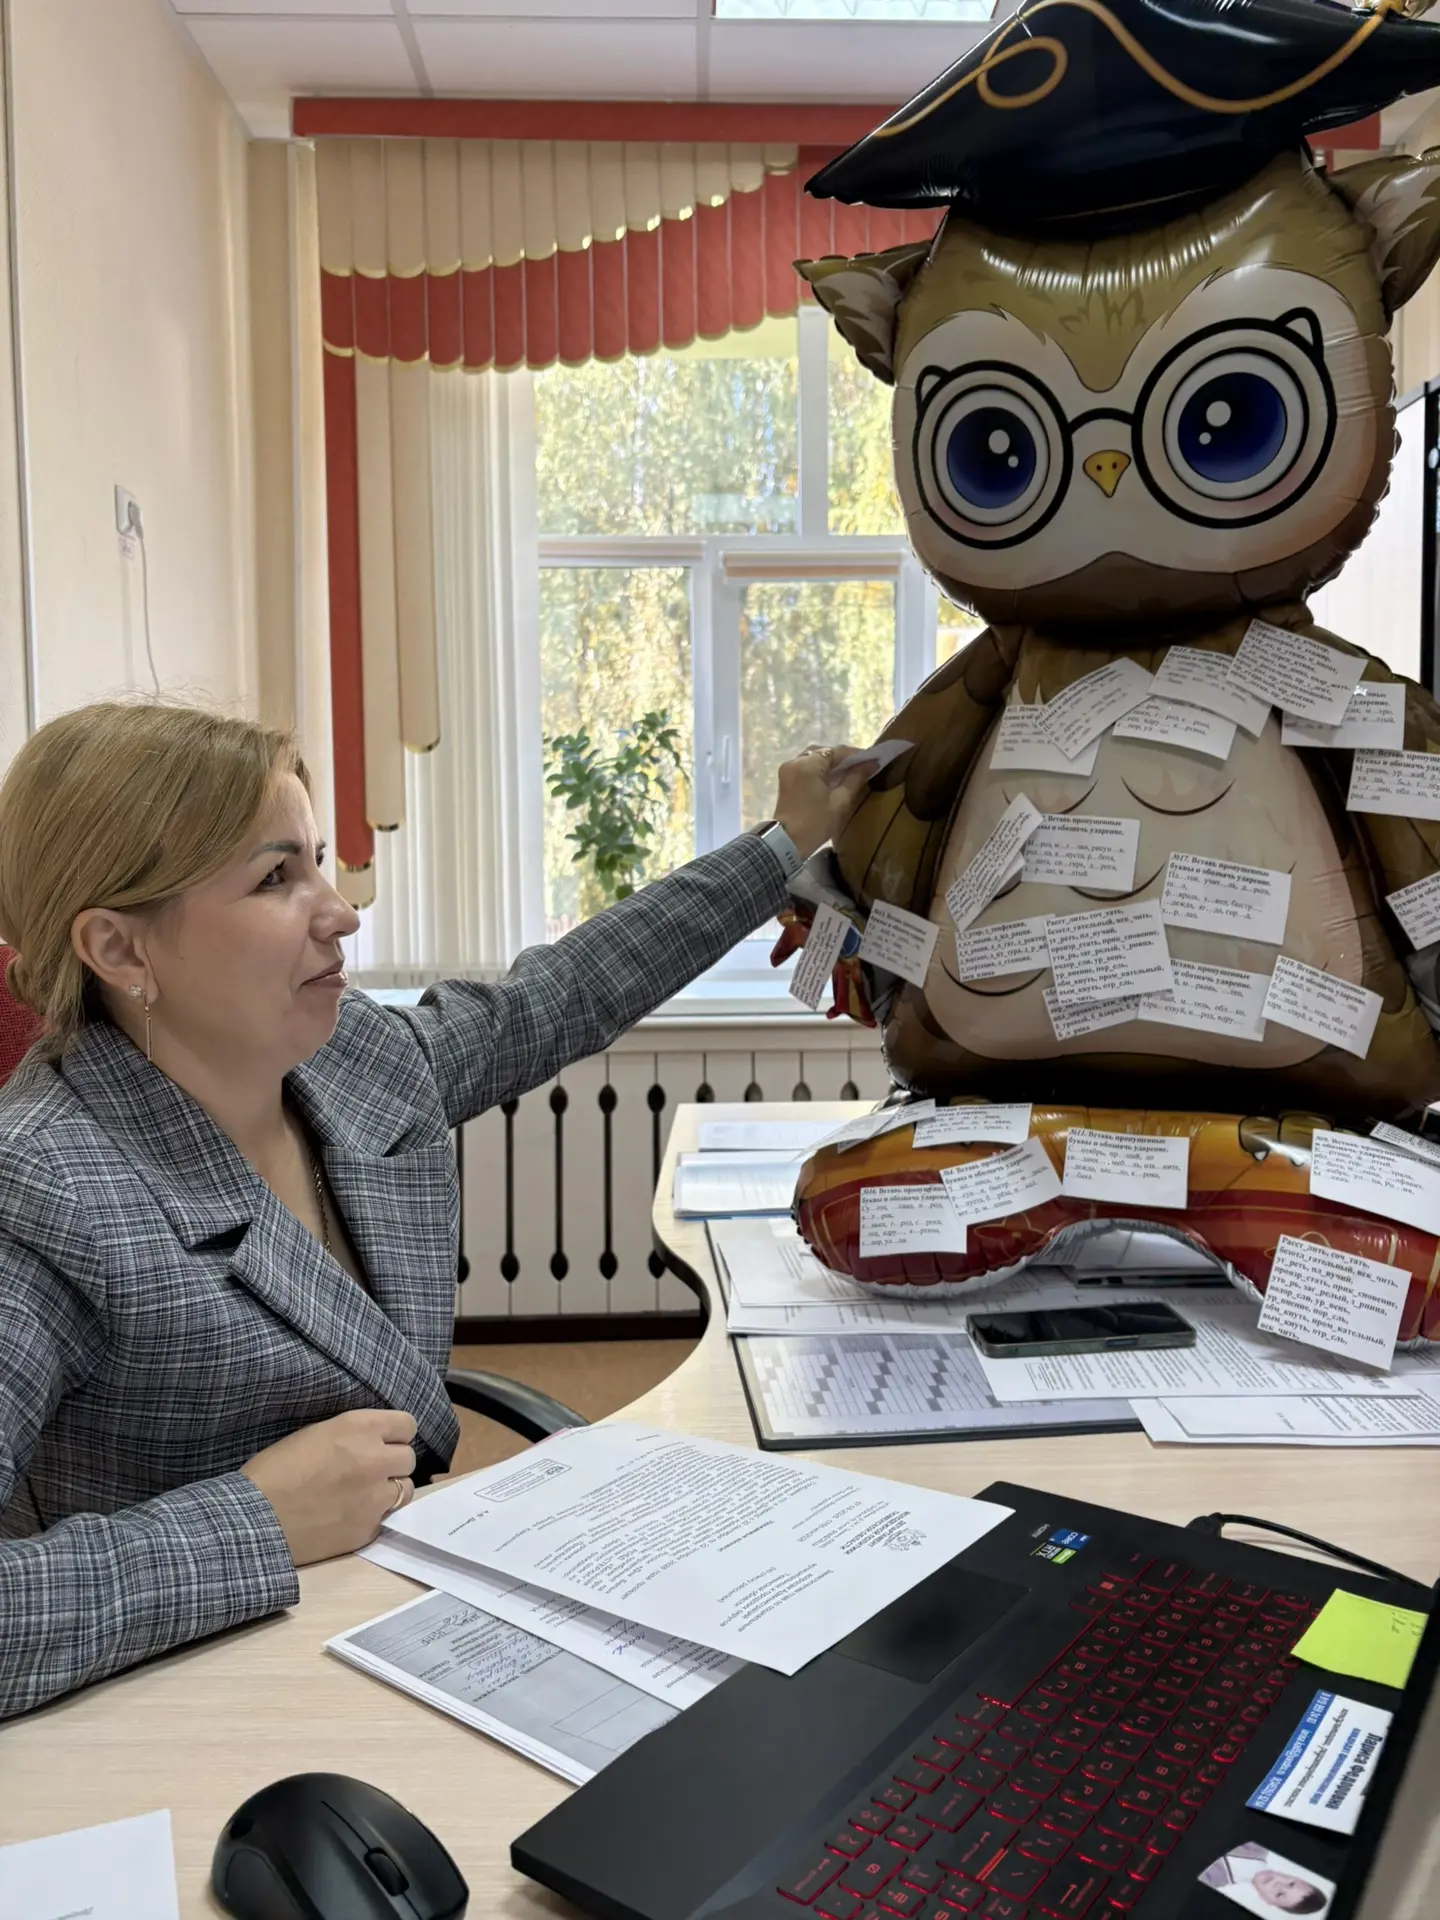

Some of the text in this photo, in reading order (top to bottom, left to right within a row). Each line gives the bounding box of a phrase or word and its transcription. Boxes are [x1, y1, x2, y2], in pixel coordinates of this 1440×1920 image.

[839, 1508, 900, 1550] ТЮМЕНСКОЙ ОБЛАСТИ
[843, 1532, 874, 1556] ПОЛИТИКИ
[867, 1519, 906, 1548] ДЕПАРТАМЕНТ
[1323, 1732, 1383, 1811] Лариса Федоровна
